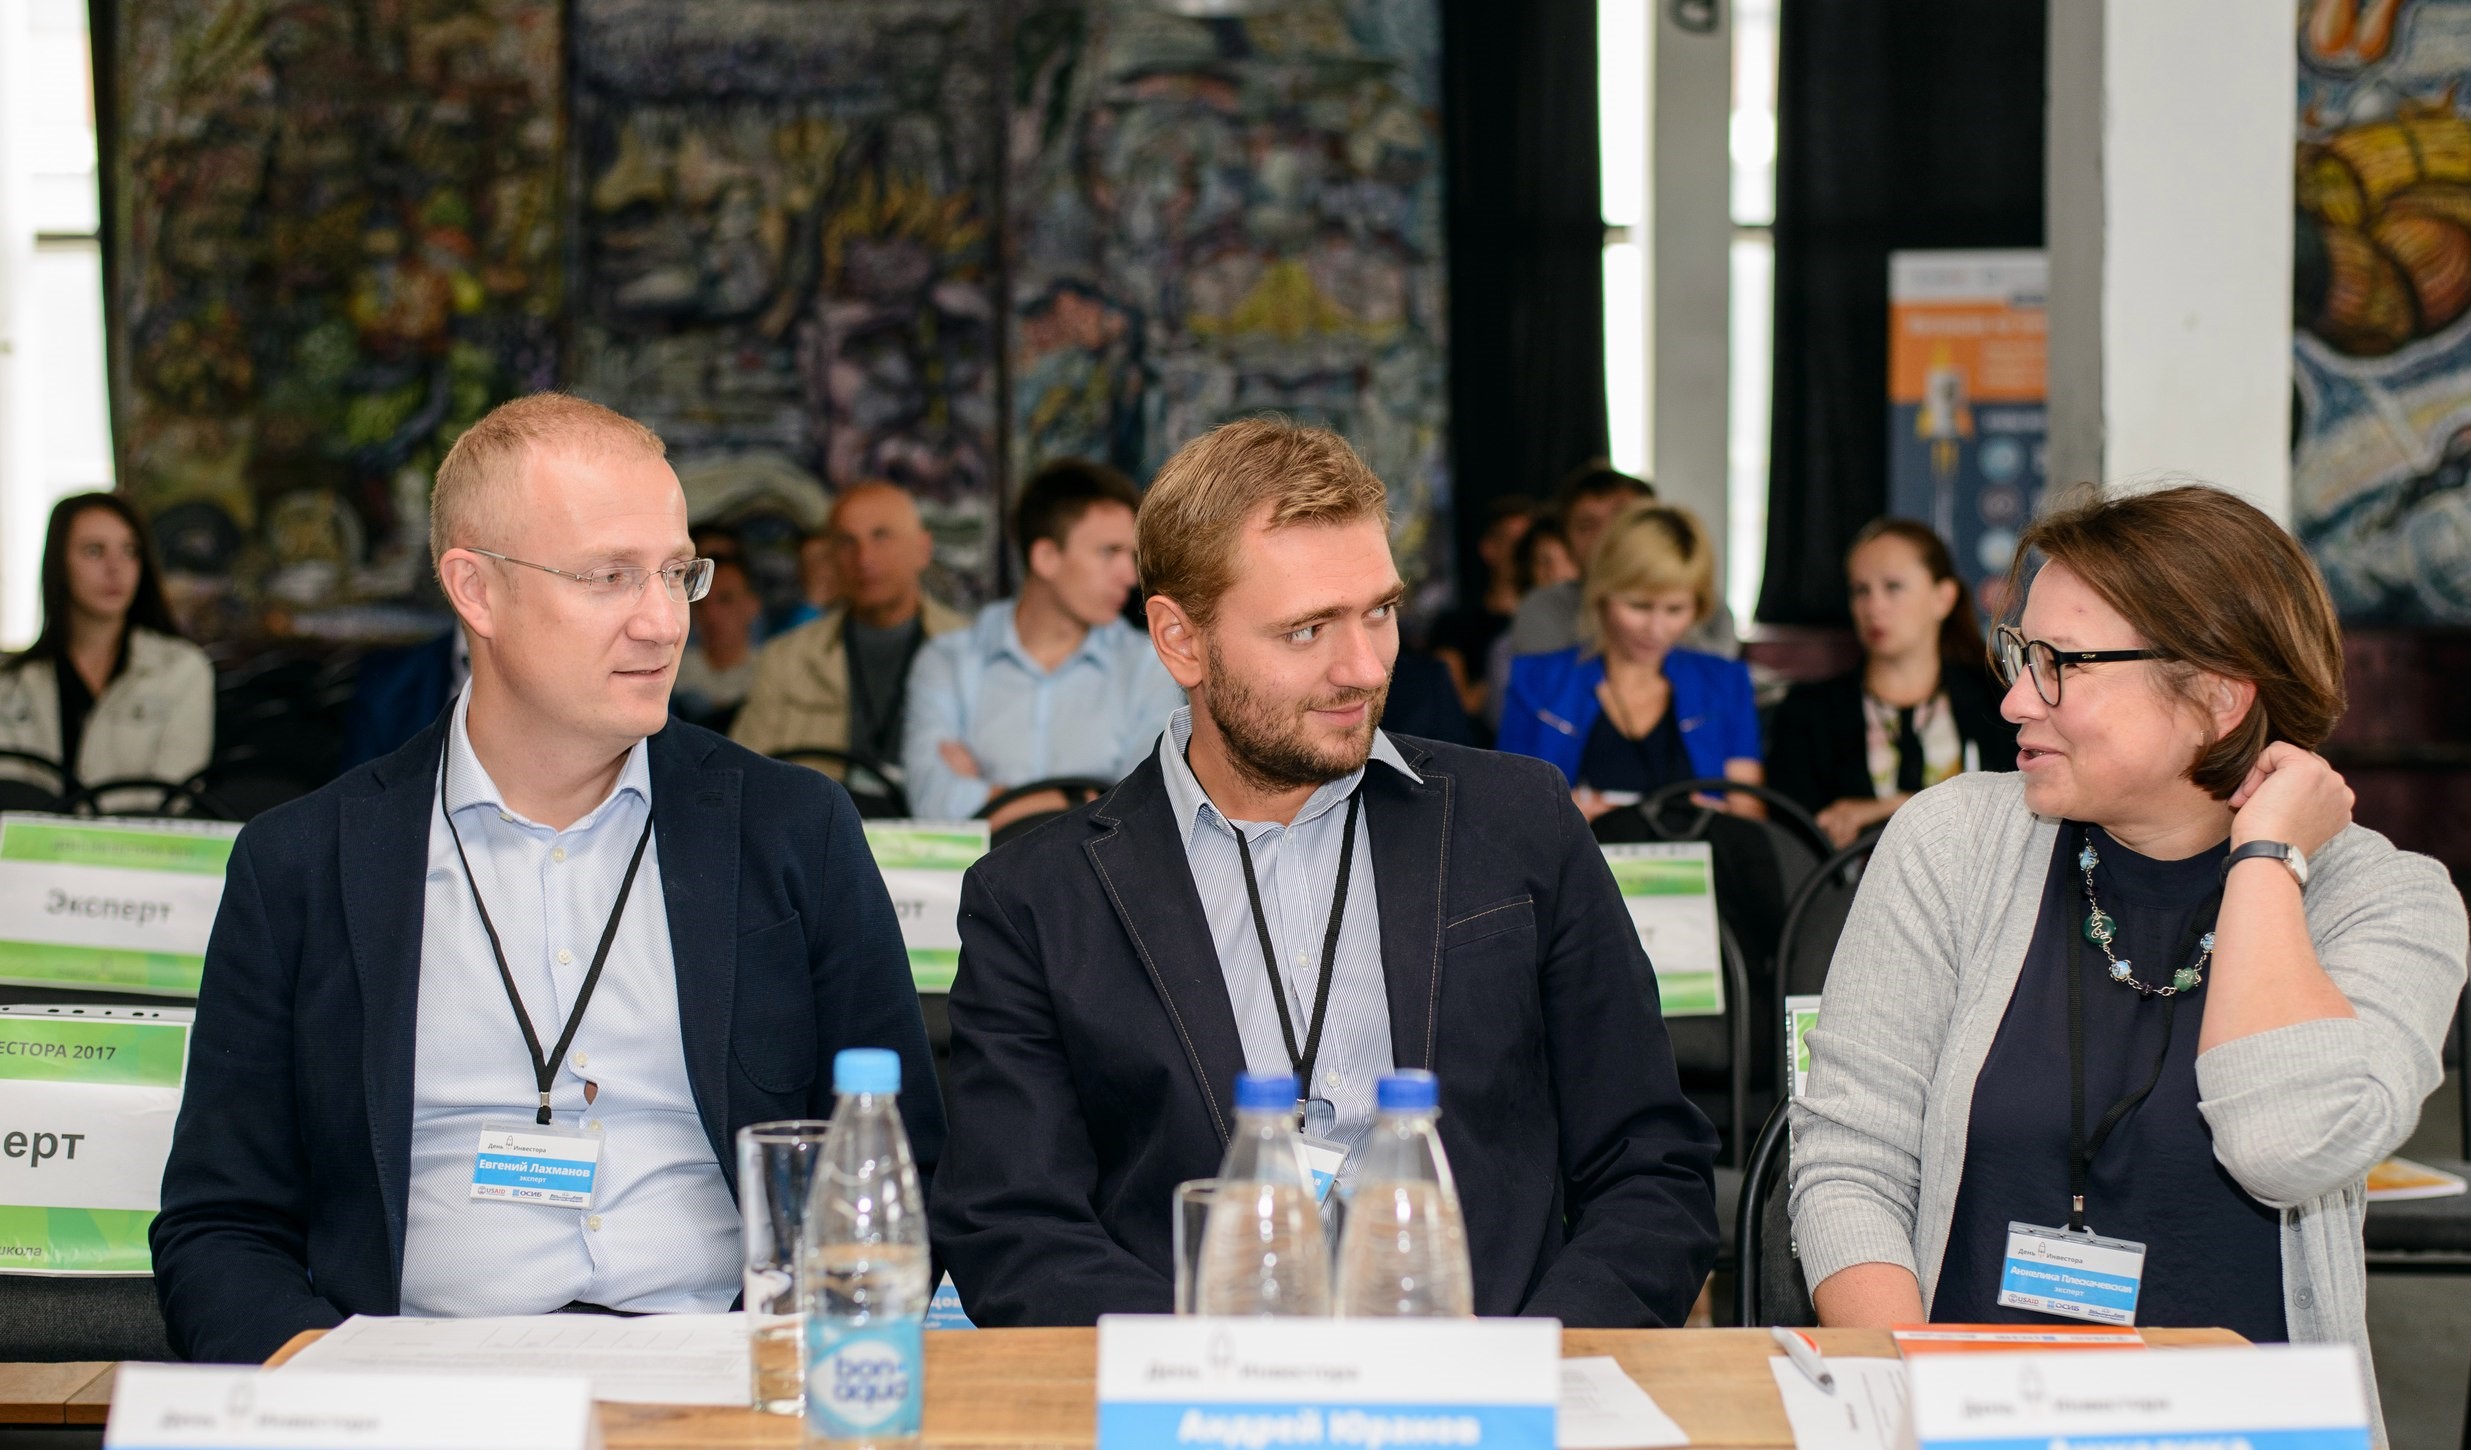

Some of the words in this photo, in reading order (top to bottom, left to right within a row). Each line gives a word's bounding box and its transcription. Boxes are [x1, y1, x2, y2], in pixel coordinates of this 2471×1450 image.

[46, 888, 173, 927] Эксперт
[73, 1045, 116, 1061] 2017
[3, 1130, 85, 1168] ерт
[513, 1145, 547, 1154] Инвестора
[479, 1159, 528, 1172] Евгений
[529, 1163, 591, 1178] Лахманов
[519, 1175, 547, 1184] эксперт
[2018, 1248, 2036, 1257] День
[2046, 1253, 2084, 1265] Инвестора
[2018, 1296, 2040, 1305] USAID
